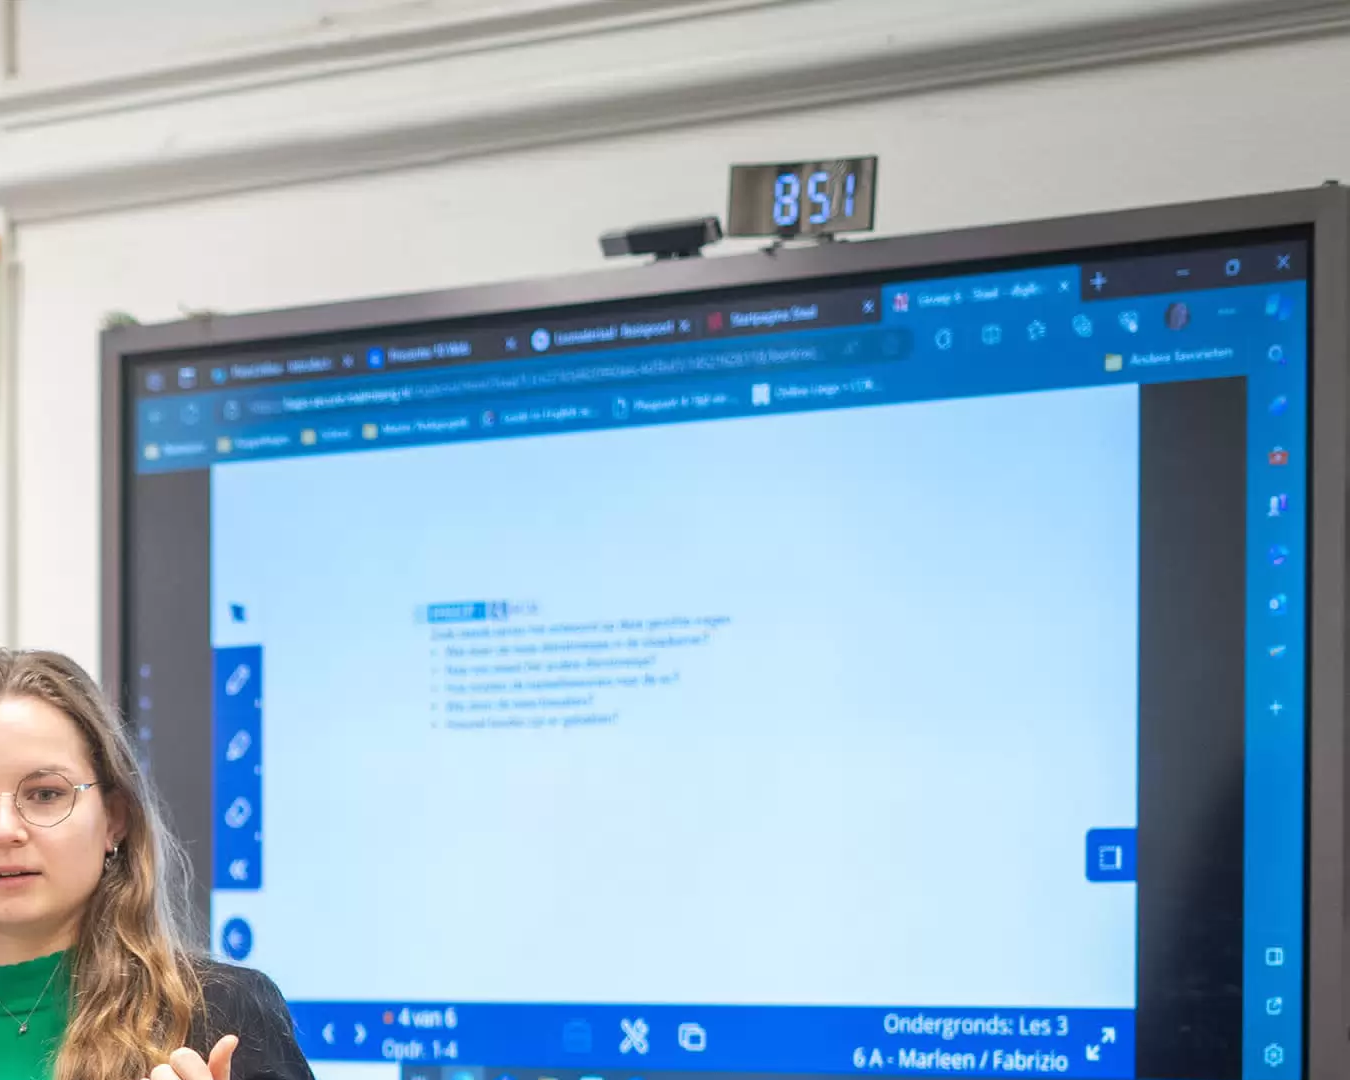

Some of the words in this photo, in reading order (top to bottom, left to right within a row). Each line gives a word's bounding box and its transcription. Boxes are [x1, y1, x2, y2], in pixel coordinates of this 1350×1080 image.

[773, 171, 855, 226] 851
[398, 1007, 409, 1026] 4
[413, 1011, 442, 1028] van
[445, 1007, 457, 1028] 6
[884, 1013, 1013, 1040] Ondergronds:
[1020, 1015, 1051, 1036] Les
[1056, 1016, 1068, 1036] 3
[433, 1039, 458, 1059] 1-4
[853, 1047, 866, 1068] 6
[869, 1048, 884, 1068] A
[899, 1048, 975, 1069] Marleen
[979, 1050, 989, 1069] /
[994, 1049, 1068, 1072] Fabrizio
